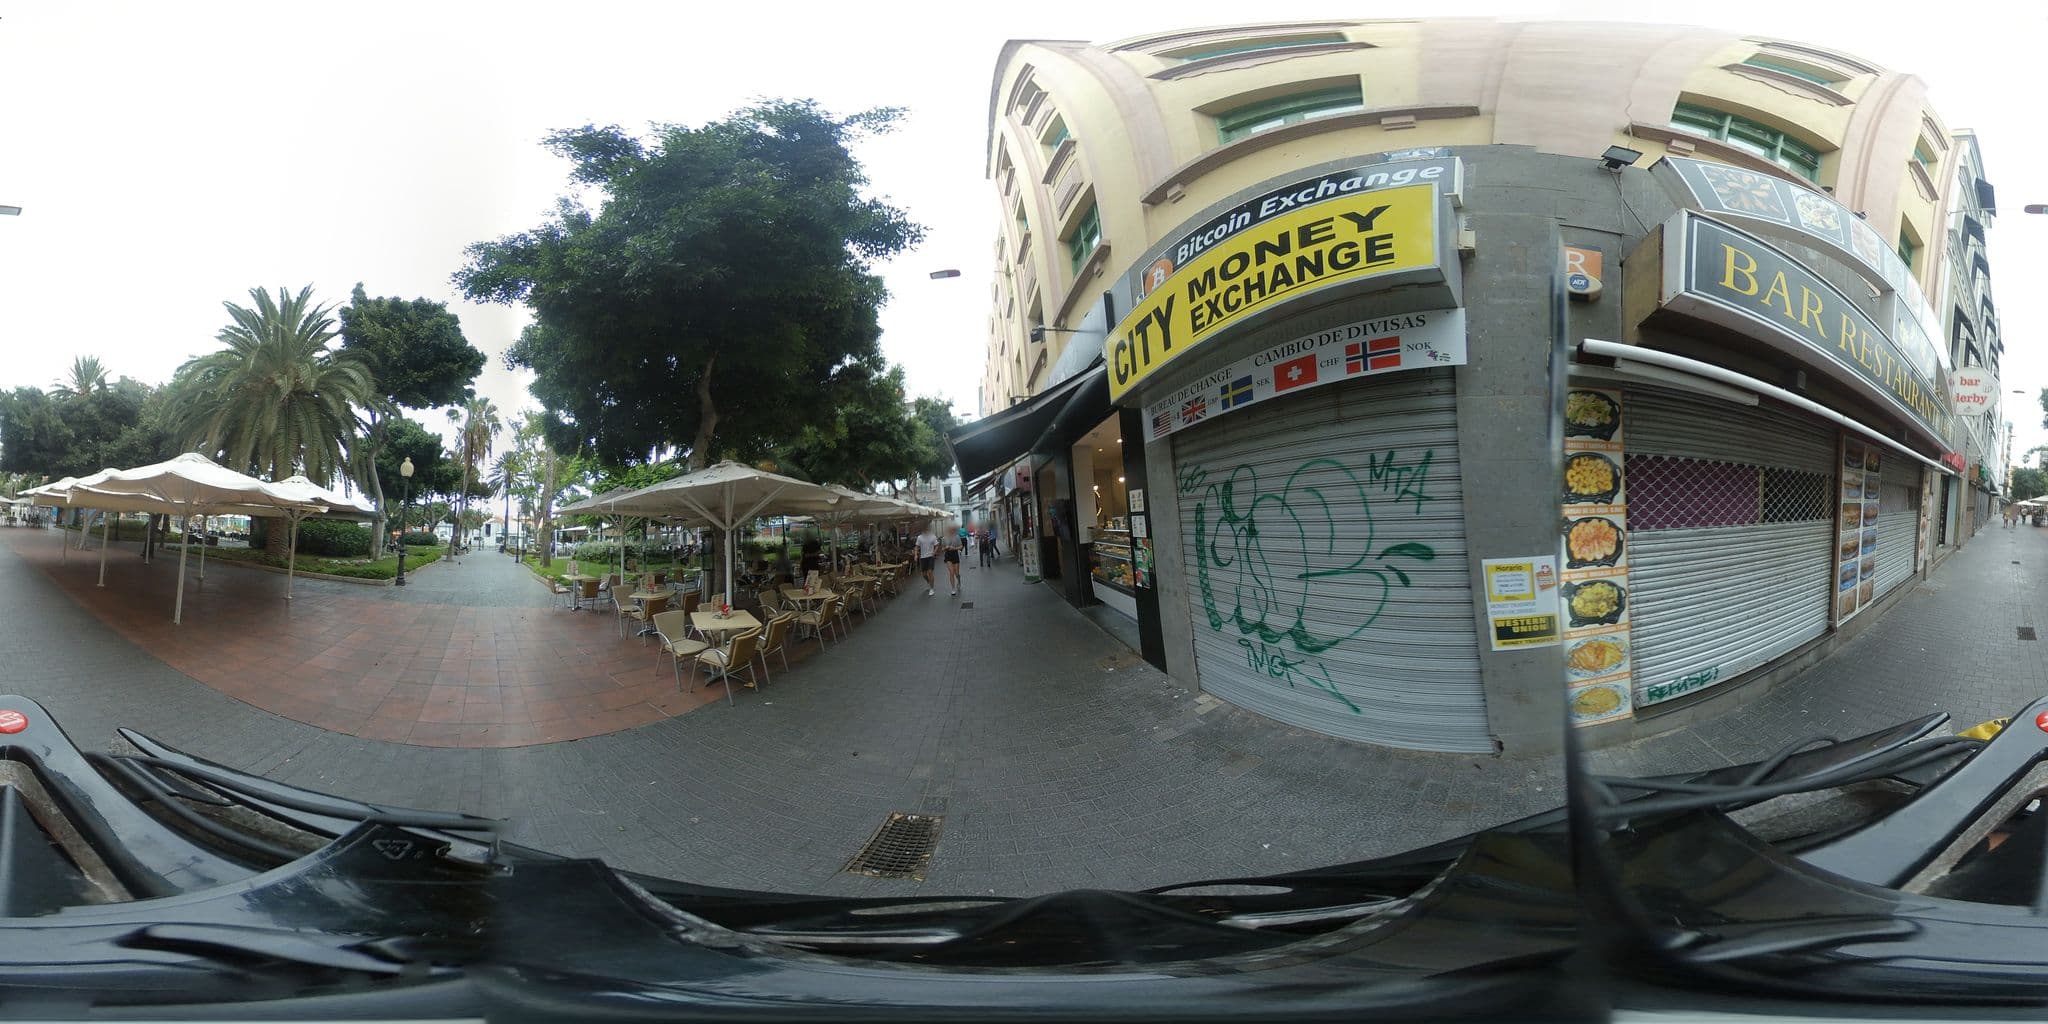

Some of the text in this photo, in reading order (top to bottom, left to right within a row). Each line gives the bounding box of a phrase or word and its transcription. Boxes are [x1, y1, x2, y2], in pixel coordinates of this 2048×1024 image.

[1177, 166, 1444, 265] Bitcoin Exchange
[1187, 205, 1392, 304] MONEY
[1192, 233, 1395, 331] EXCHANGE
[1719, 243, 1827, 339] BAR
[1115, 293, 1175, 385] CITY
[1254, 314, 1426, 367] CAMBIO DE DIVISAS
[1320, 357, 1340, 368] CHF
[1406, 341, 1432, 352] NOK
[1150, 368, 1233, 416] BUREAU DE CHANGE
[1256, 377, 1271, 387] SEK
[1960, 376, 1981, 387] bar
[1495, 617, 1546, 628] WESTERN
[1512, 624, 1548, 633] UNION
